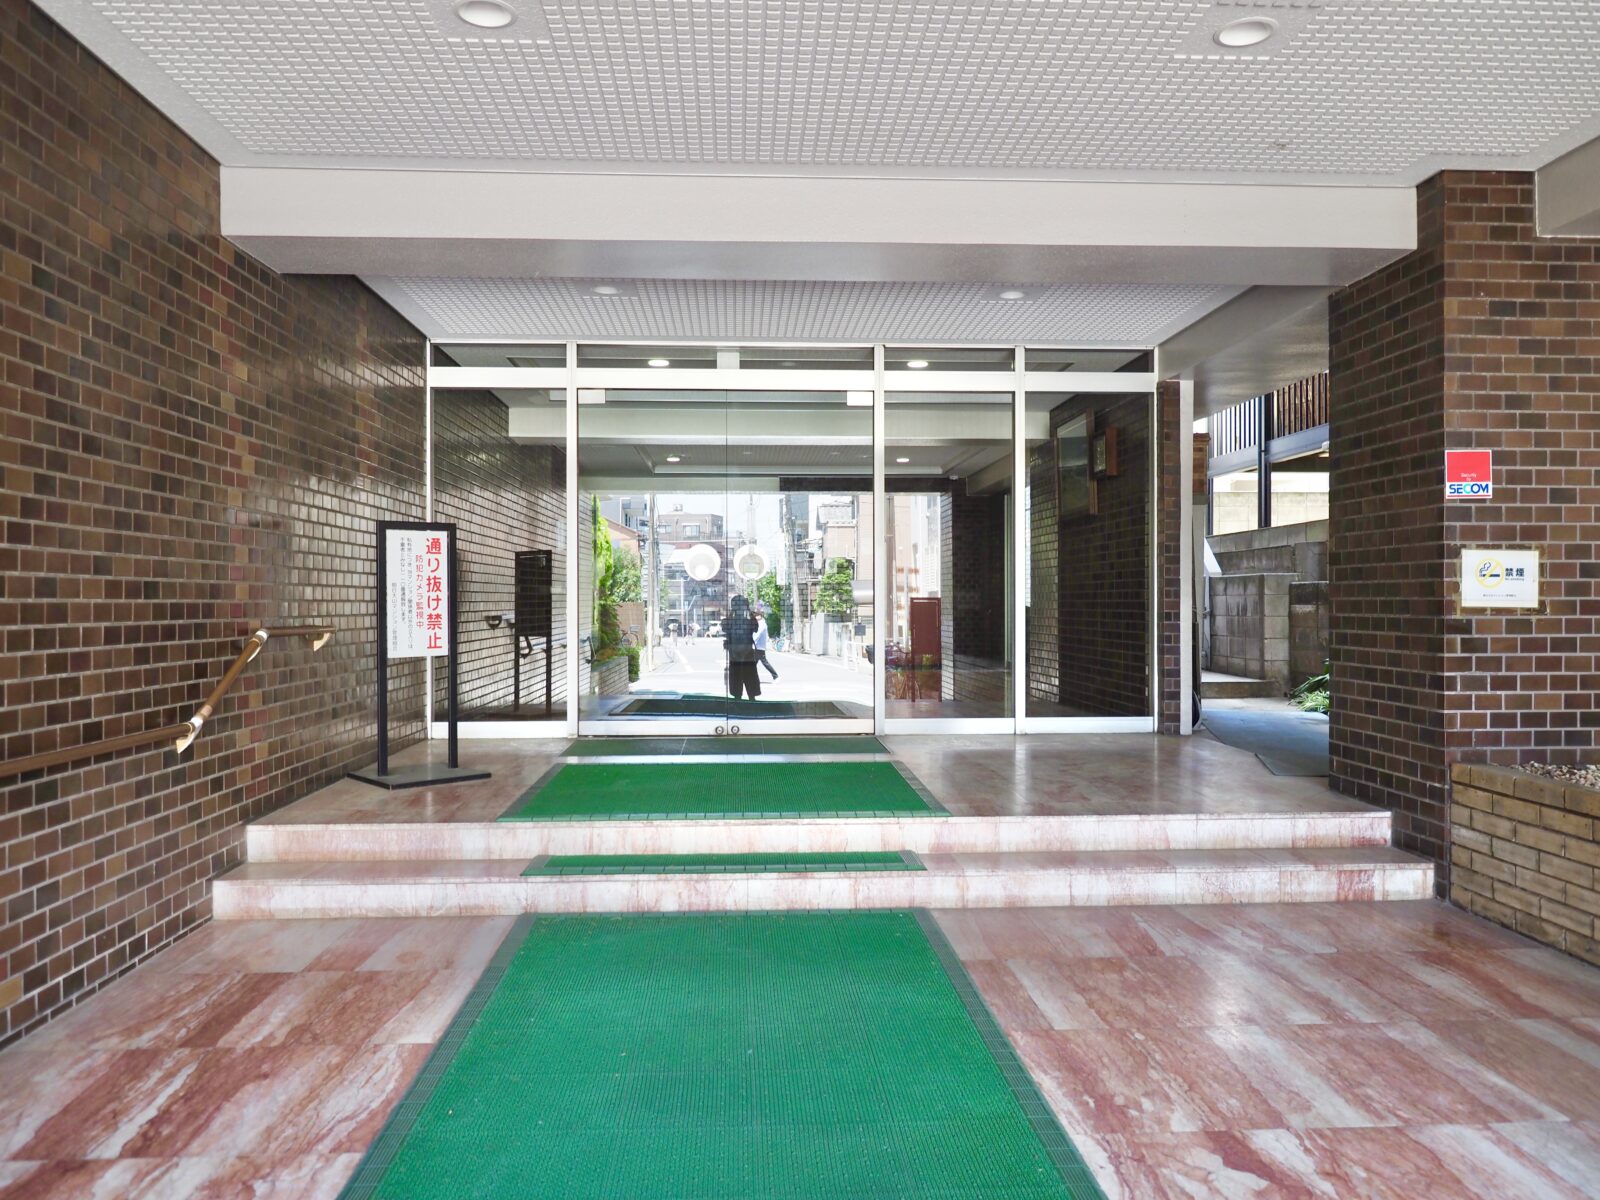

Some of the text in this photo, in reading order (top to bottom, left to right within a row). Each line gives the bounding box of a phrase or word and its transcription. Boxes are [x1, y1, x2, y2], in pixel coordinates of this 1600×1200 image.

[1449, 483, 1489, 494] SECOM
[415, 554, 425, 629] 防犯カメラ監視中
[425, 537, 443, 650] 通り抜け禁止
[1505, 567, 1525, 577] 禁煙
